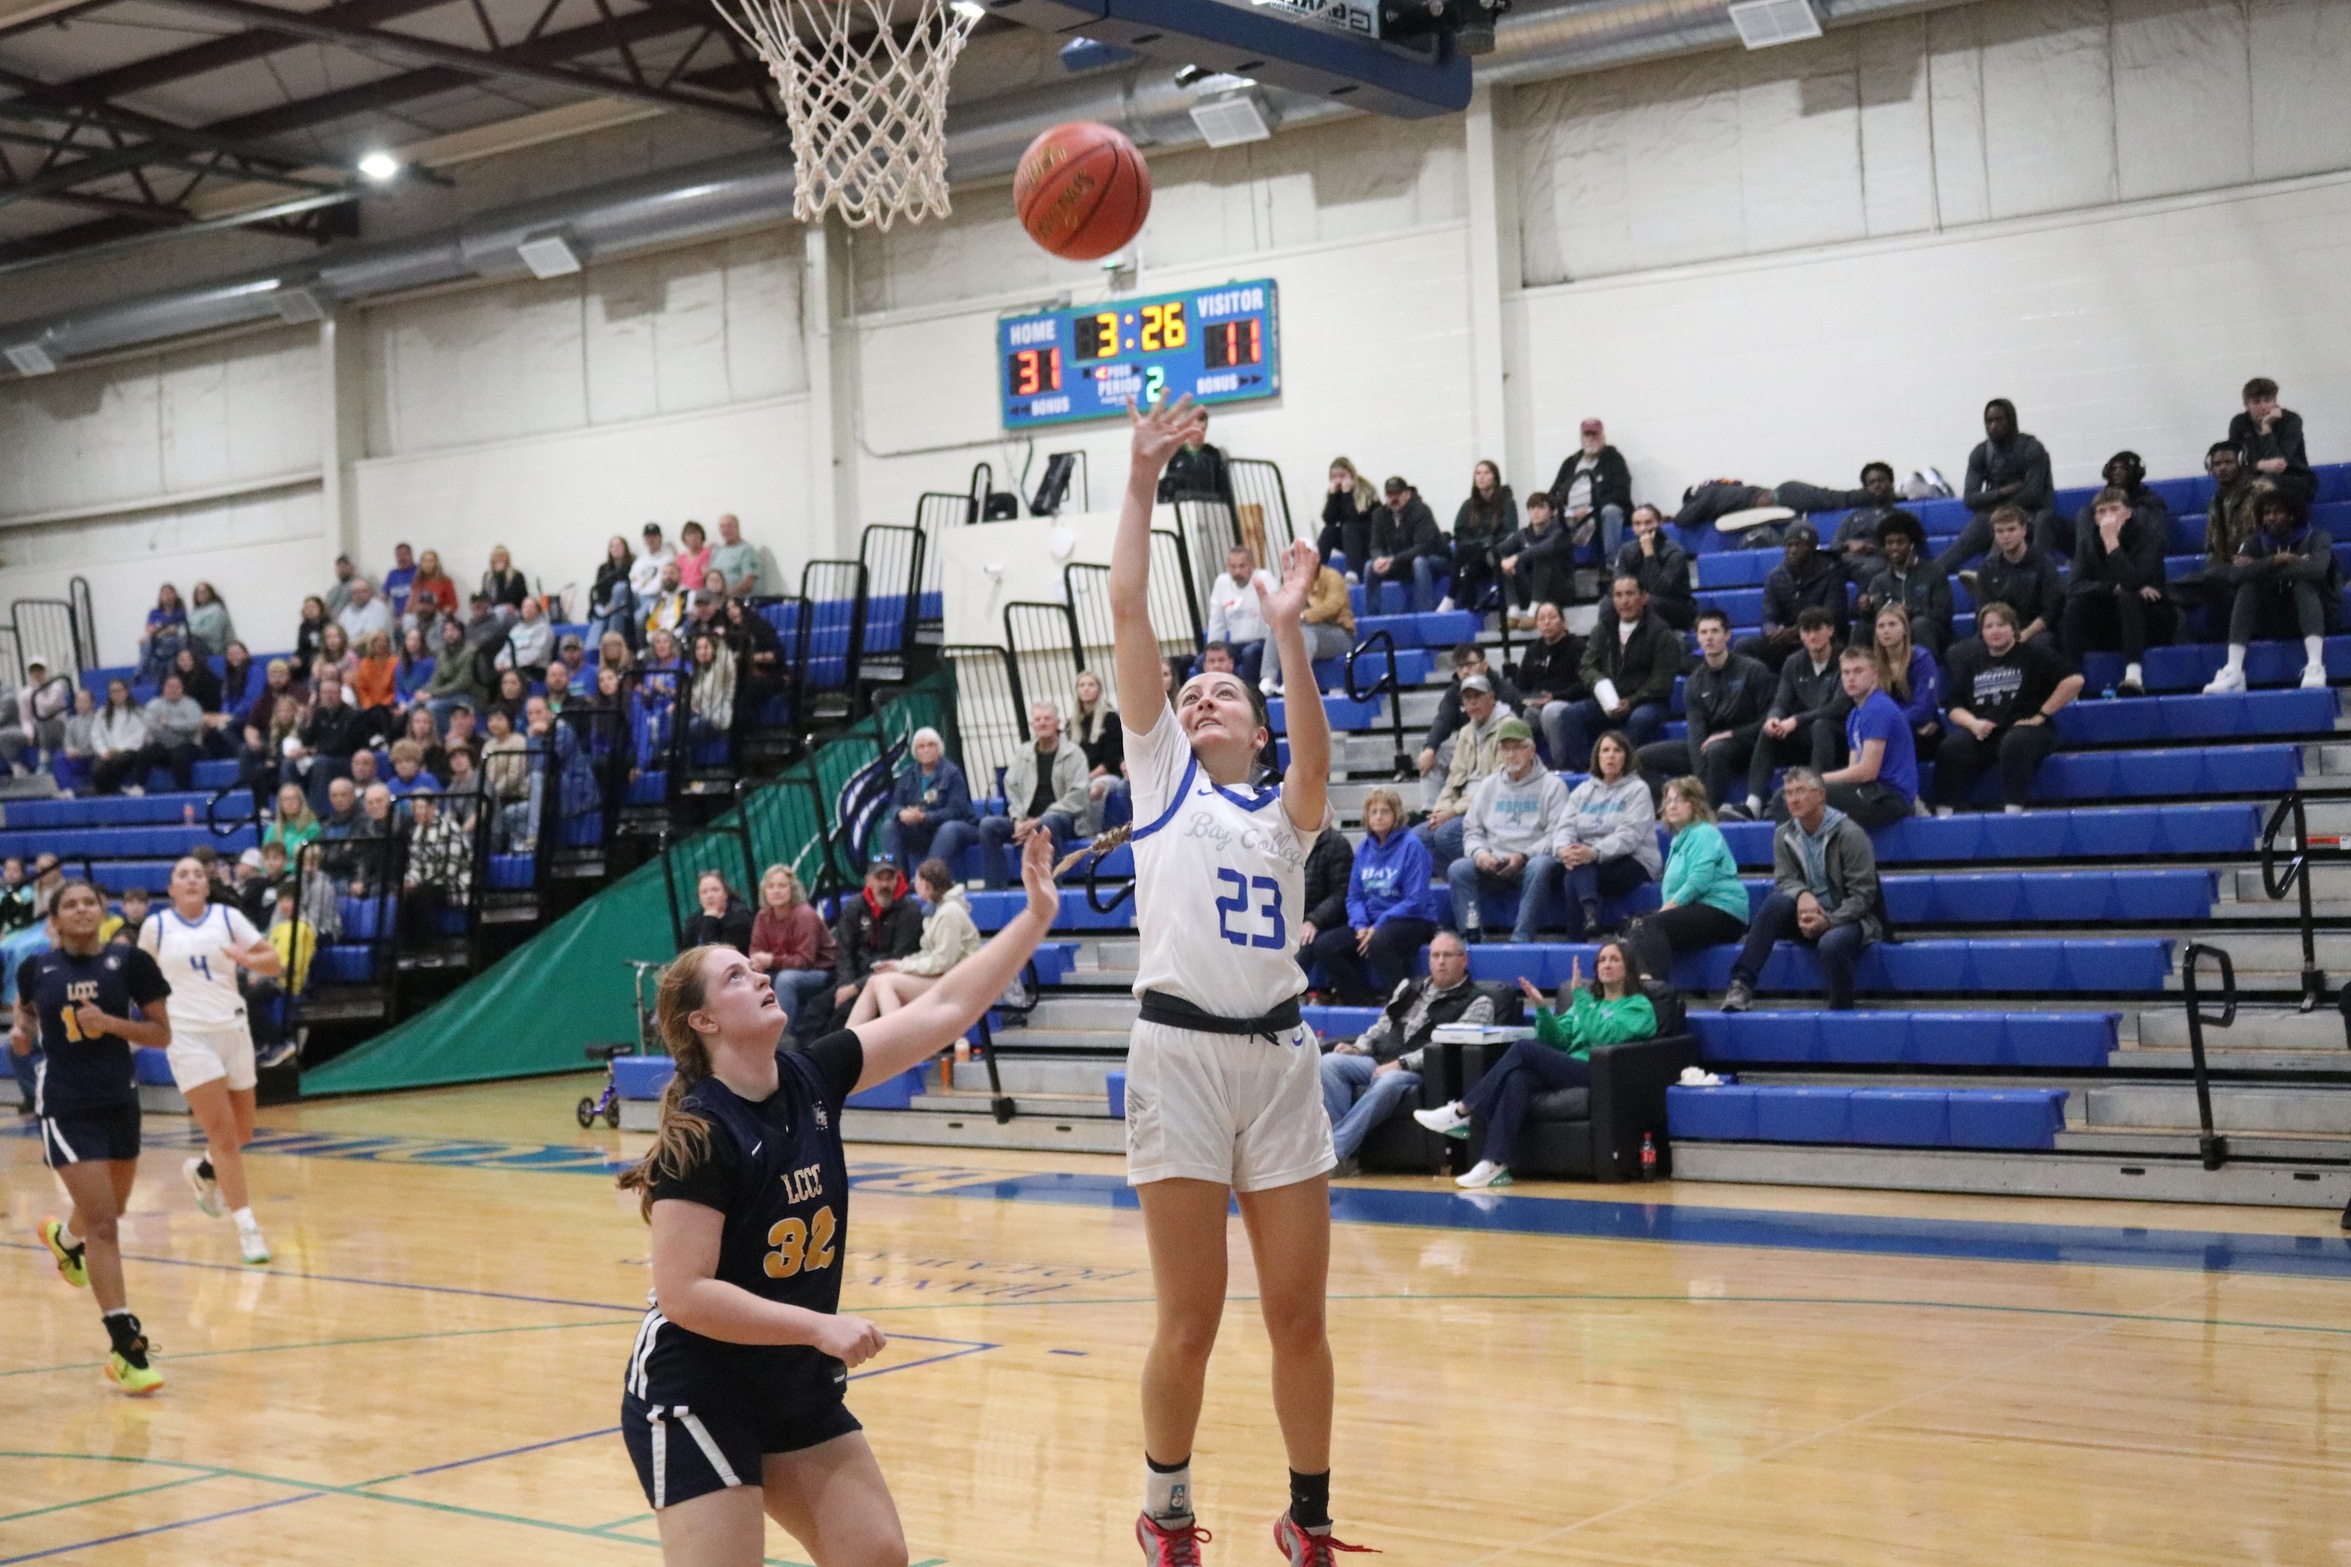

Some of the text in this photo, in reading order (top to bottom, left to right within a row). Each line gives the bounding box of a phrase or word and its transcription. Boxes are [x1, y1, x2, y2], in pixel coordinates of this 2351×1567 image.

[1197, 287, 1264, 318] VISITOR
[1010, 319, 1056, 345] HOME
[1097, 302, 1187, 358] 3:26
[1227, 318, 1261, 366] 11
[1018, 347, 1062, 395] 31
[1097, 376, 1142, 397] PERIOD
[1146, 366, 1165, 403] 2
[1197, 374, 1238, 395] BONUS
[1031, 396, 1070, 415] BONUS
[1184, 811, 1305, 873] Bay Colleg
[1216, 867, 1286, 950] 23
[190, 955, 212, 981] 4
[66, 980, 99, 1001] LCCC
[780, 1163, 823, 1205] LCCC
[763, 1205, 838, 1279] 32
